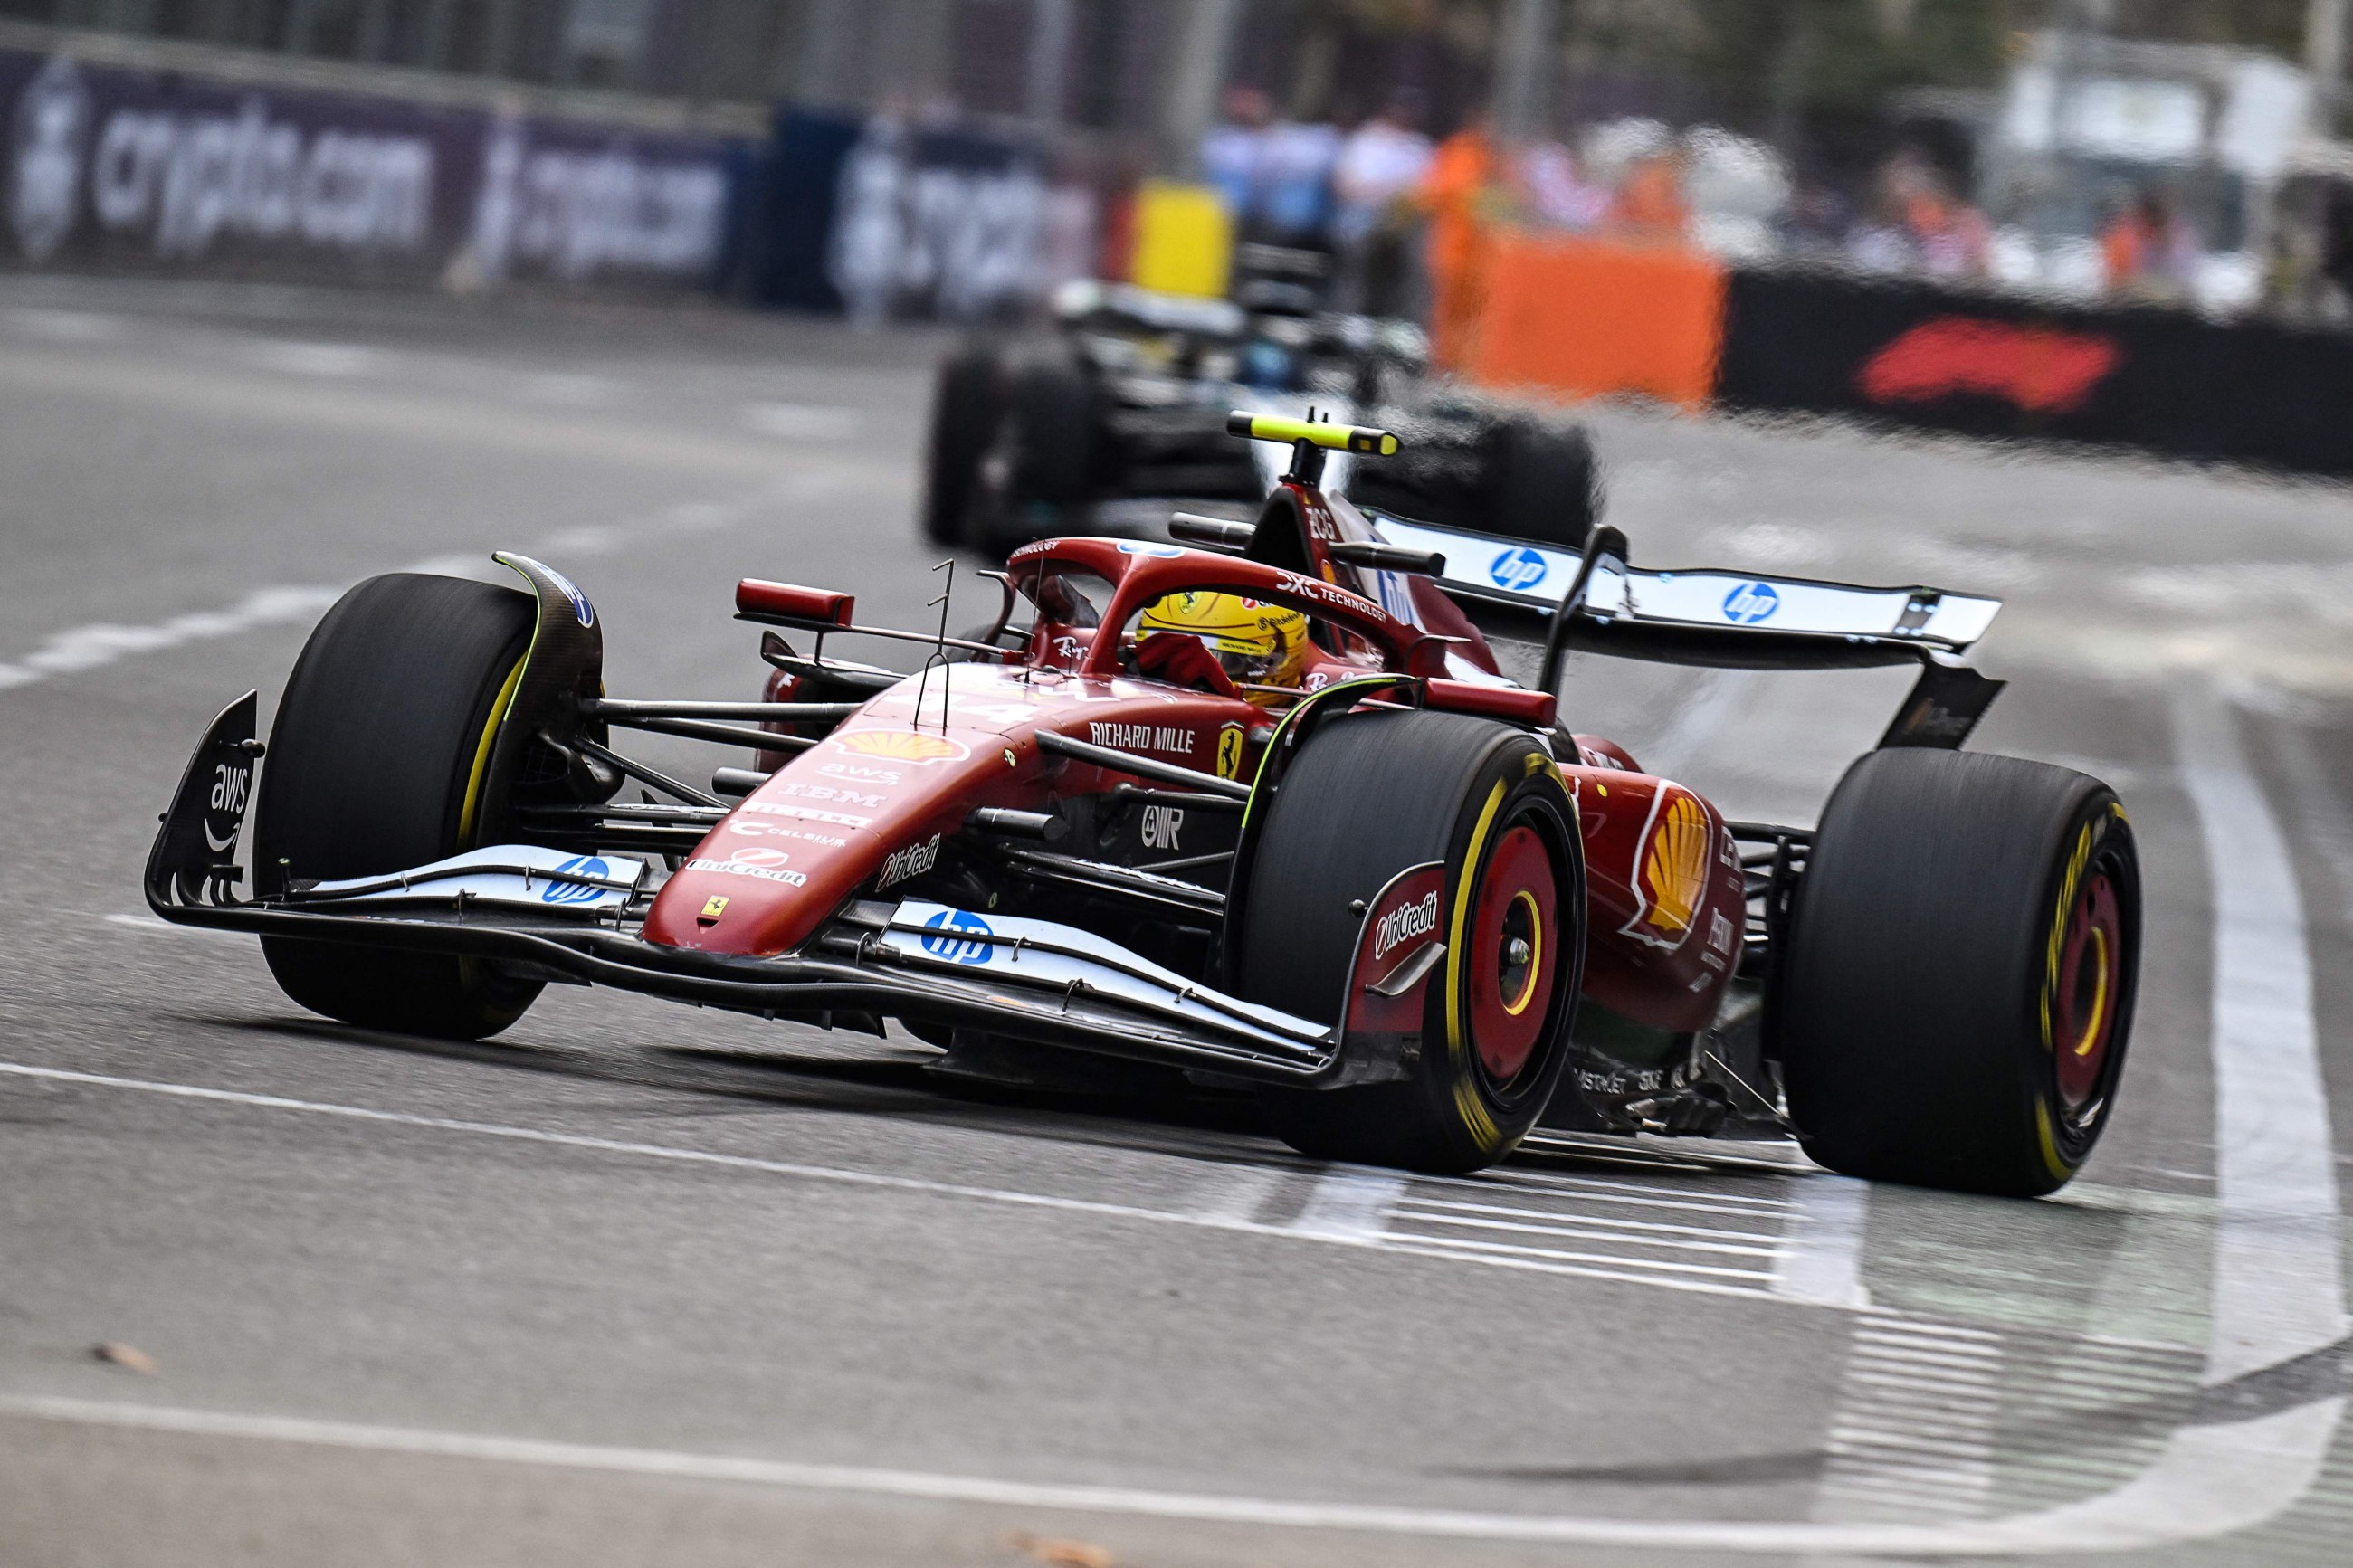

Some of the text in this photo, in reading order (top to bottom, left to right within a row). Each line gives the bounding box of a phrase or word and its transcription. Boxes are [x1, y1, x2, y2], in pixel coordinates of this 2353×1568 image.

[1493, 547, 1546, 589] hp
[1320, 588, 1387, 623] TECHNOLOGY
[1725, 584, 1777, 622] hp
[1089, 722, 1195, 754] RICHARD MILLE
[211, 764, 248, 814] aws
[820, 763, 902, 781] aws
[776, 783, 888, 808] IBM
[686, 859, 806, 886] UniCredit
[887, 832, 940, 886] UniCredit
[929, 909, 990, 963] hp
[1386, 891, 1437, 950] UniCredit
